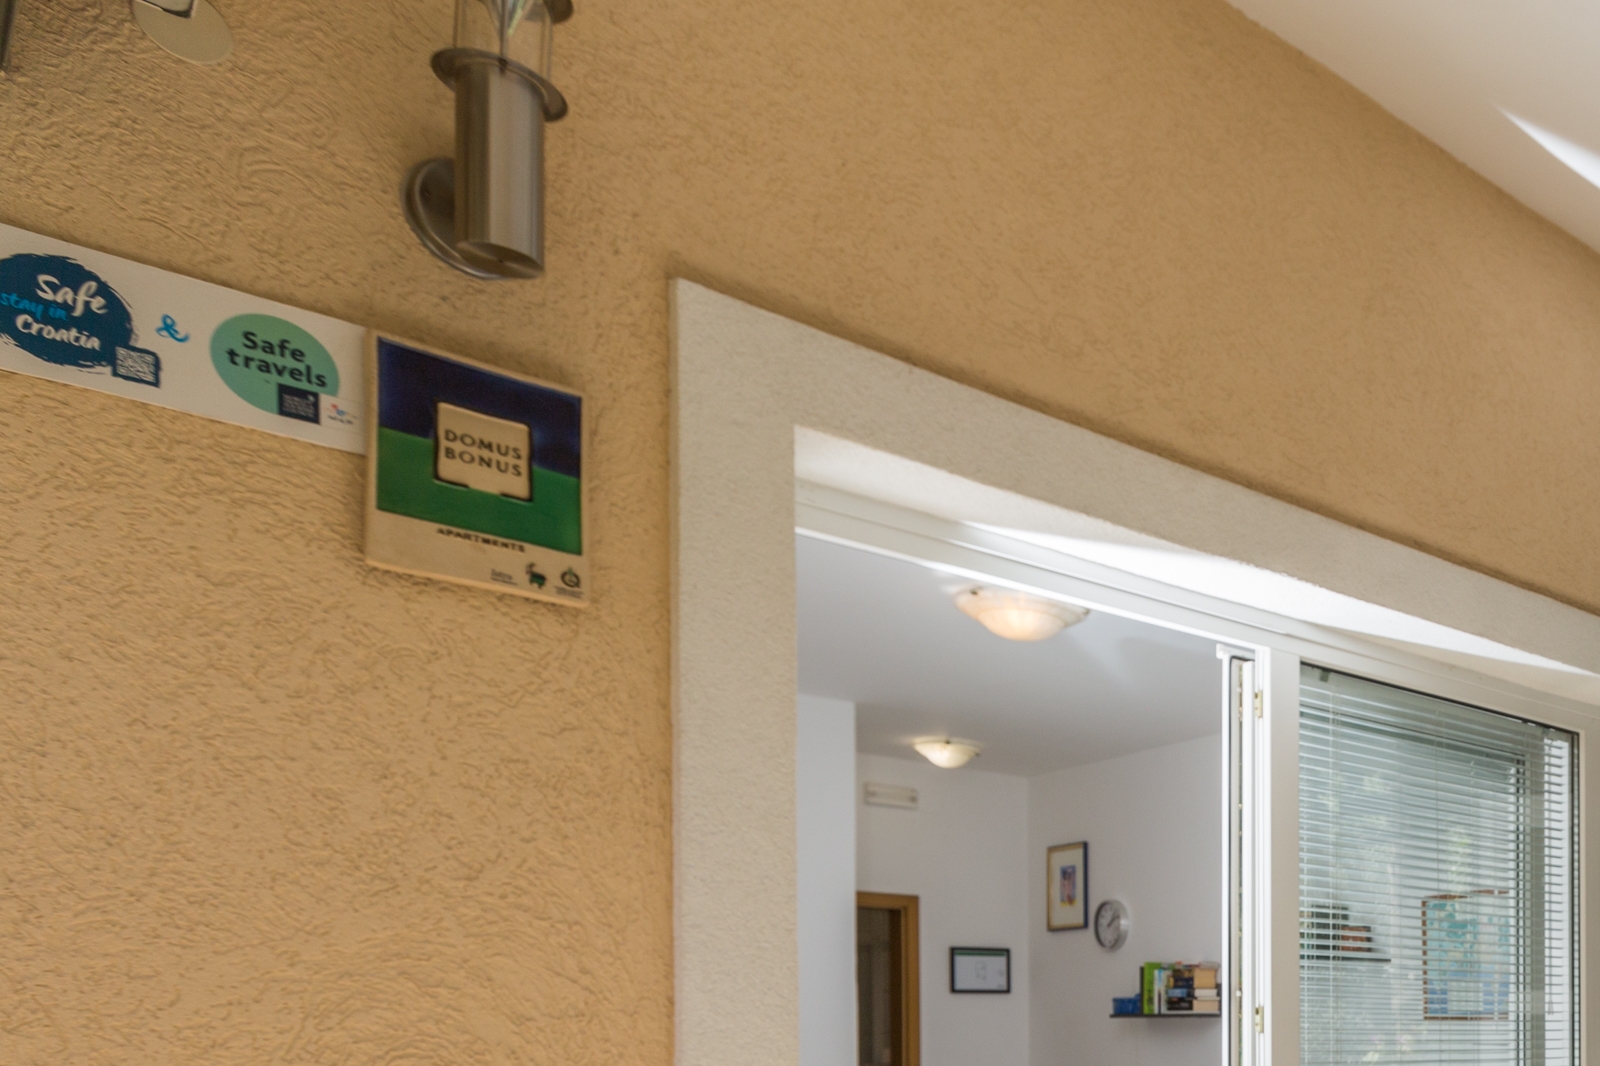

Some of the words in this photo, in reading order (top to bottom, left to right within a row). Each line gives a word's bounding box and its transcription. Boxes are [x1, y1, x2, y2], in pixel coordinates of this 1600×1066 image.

[0, 292, 45, 320] stay
[48, 303, 68, 321] in
[35, 273, 108, 317] Safe
[16, 314, 101, 350] Croatia
[156, 314, 190, 343] &
[242, 330, 306, 363] Safe
[227, 348, 328, 388] travels
[444, 429, 522, 460] DOMUS
[444, 447, 522, 477] BONUS
[437, 527, 526, 553] APARTMENTS
